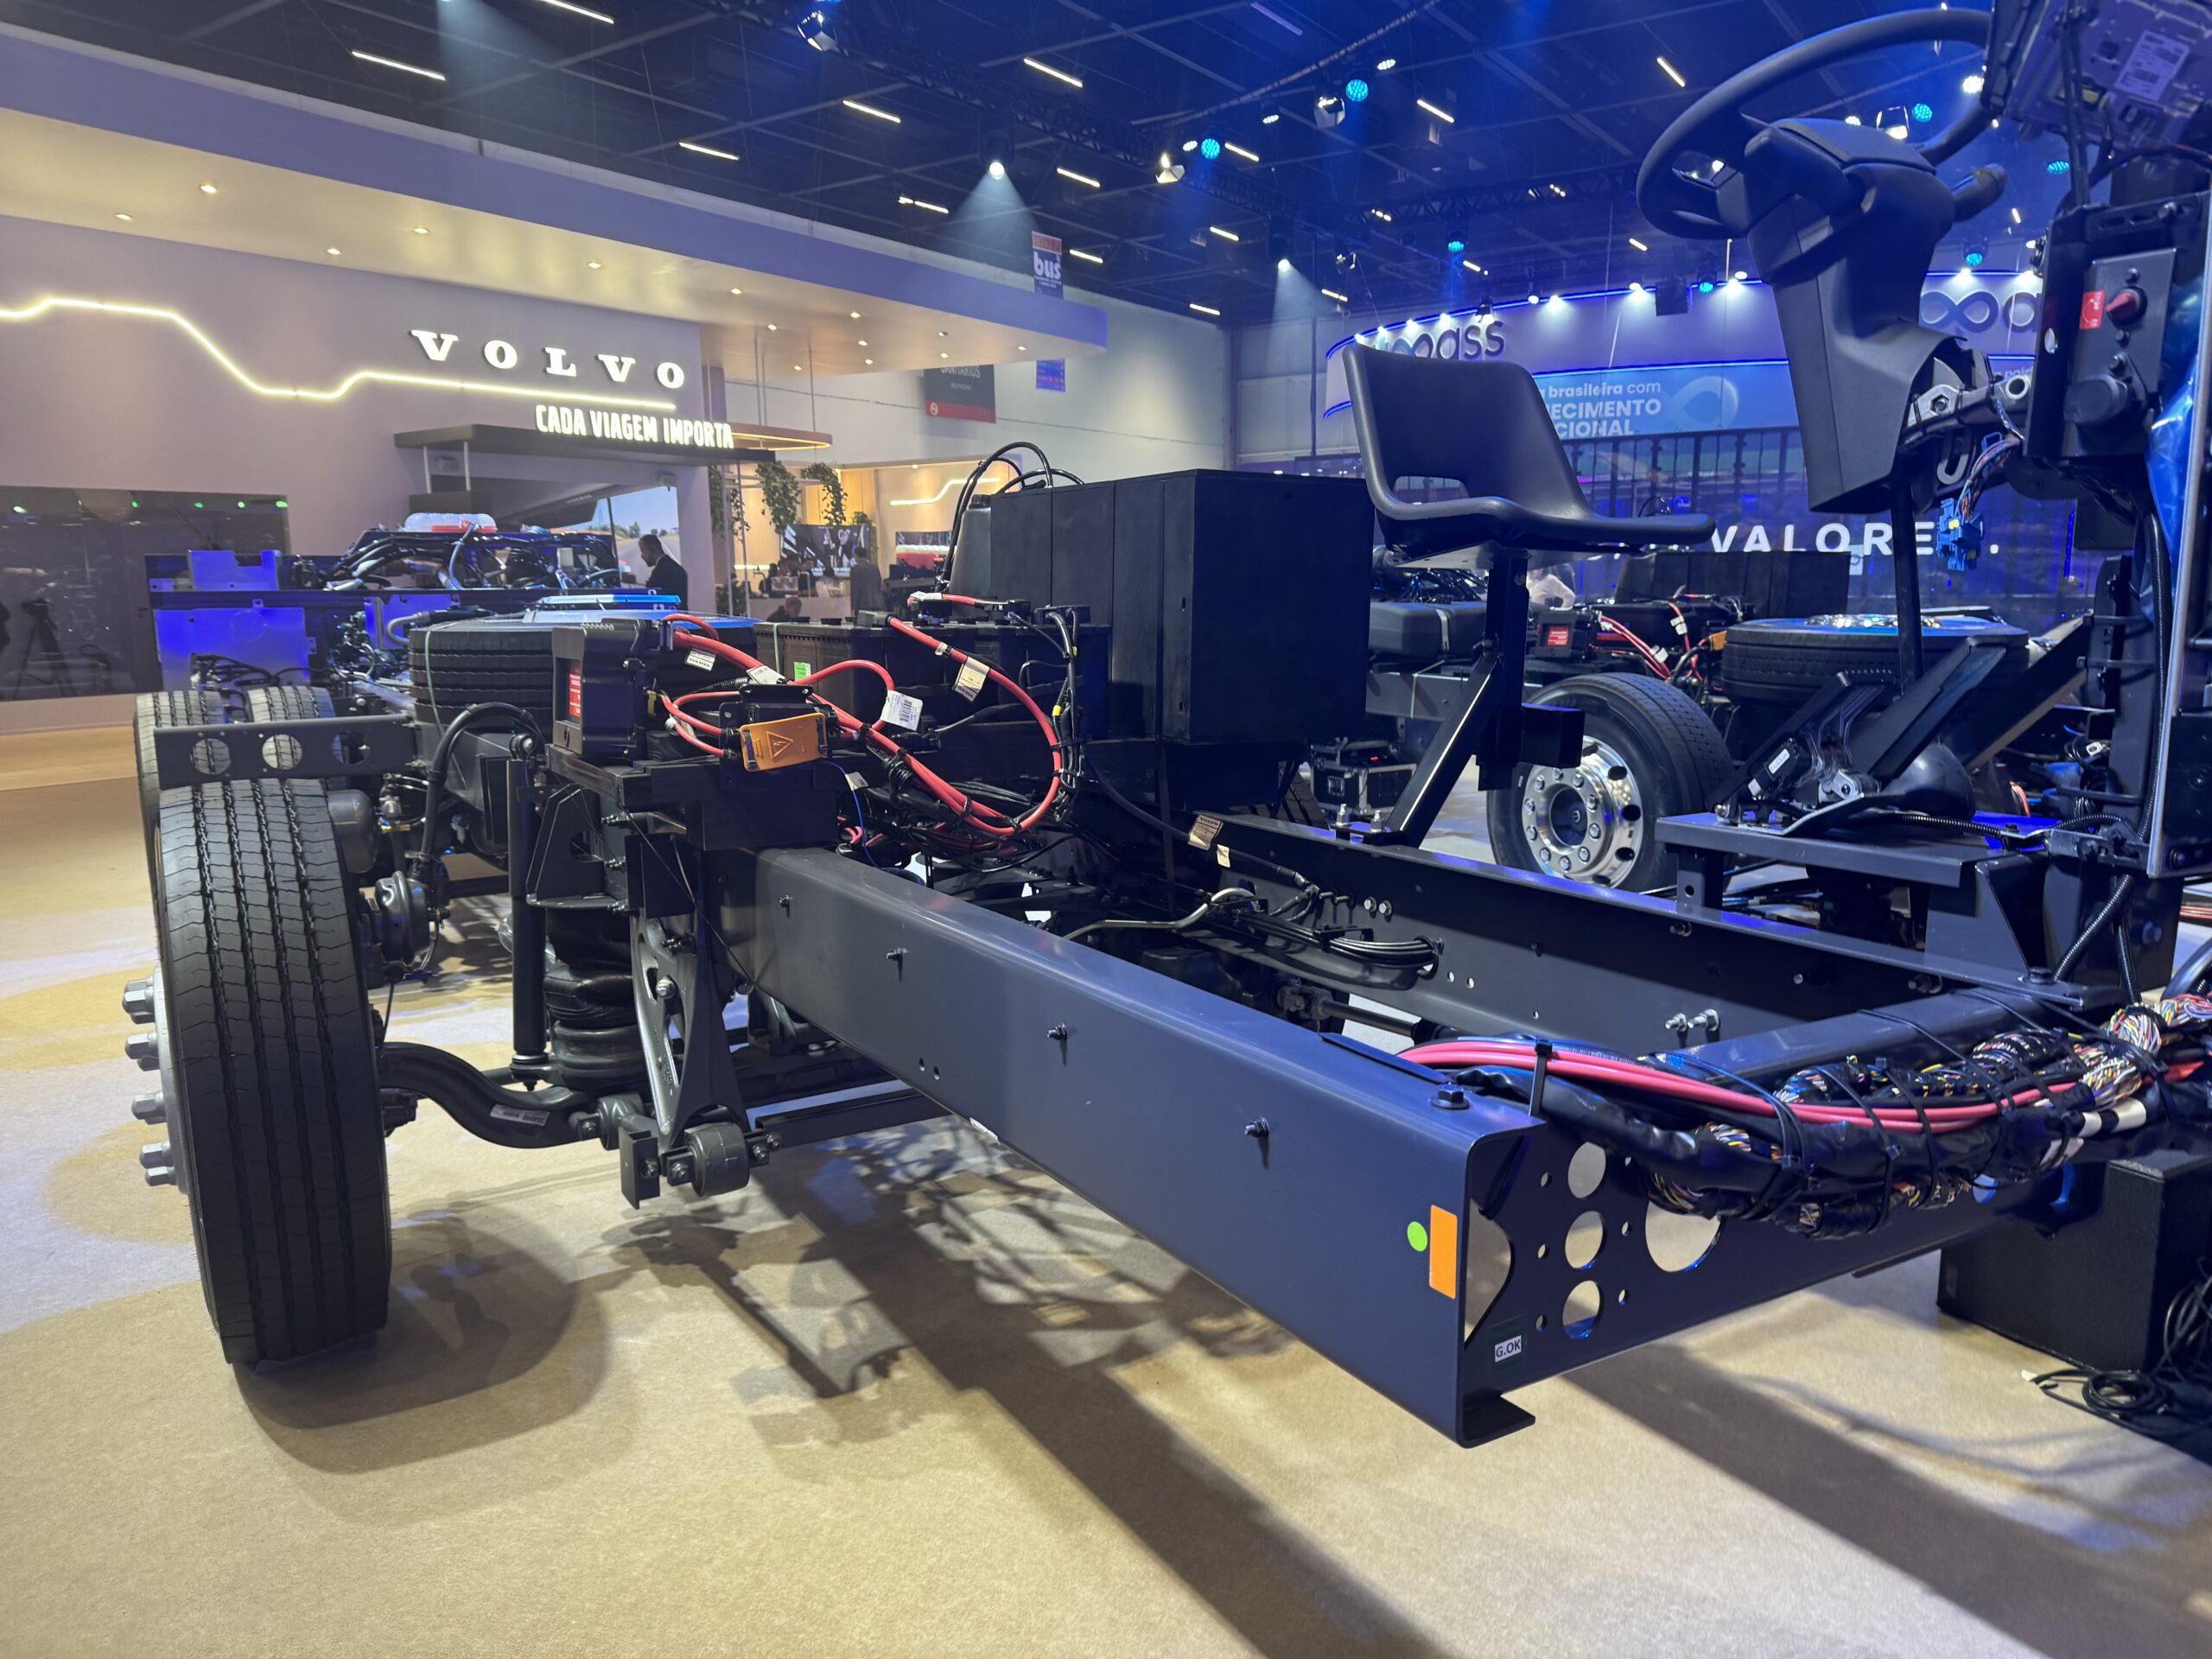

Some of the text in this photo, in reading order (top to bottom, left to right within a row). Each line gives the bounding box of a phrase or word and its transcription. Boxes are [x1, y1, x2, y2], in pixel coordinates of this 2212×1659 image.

[410, 329, 685, 389] VOLVO
[1626, 382, 1662, 394] com
[1547, 398, 1662, 420] ECIMENTO
[535, 404, 734, 449] CADA VIAGEM IMPORTA
[1555, 418, 1636, 439] CIONAL
[1496, 1338, 1521, 1357] G.OK
